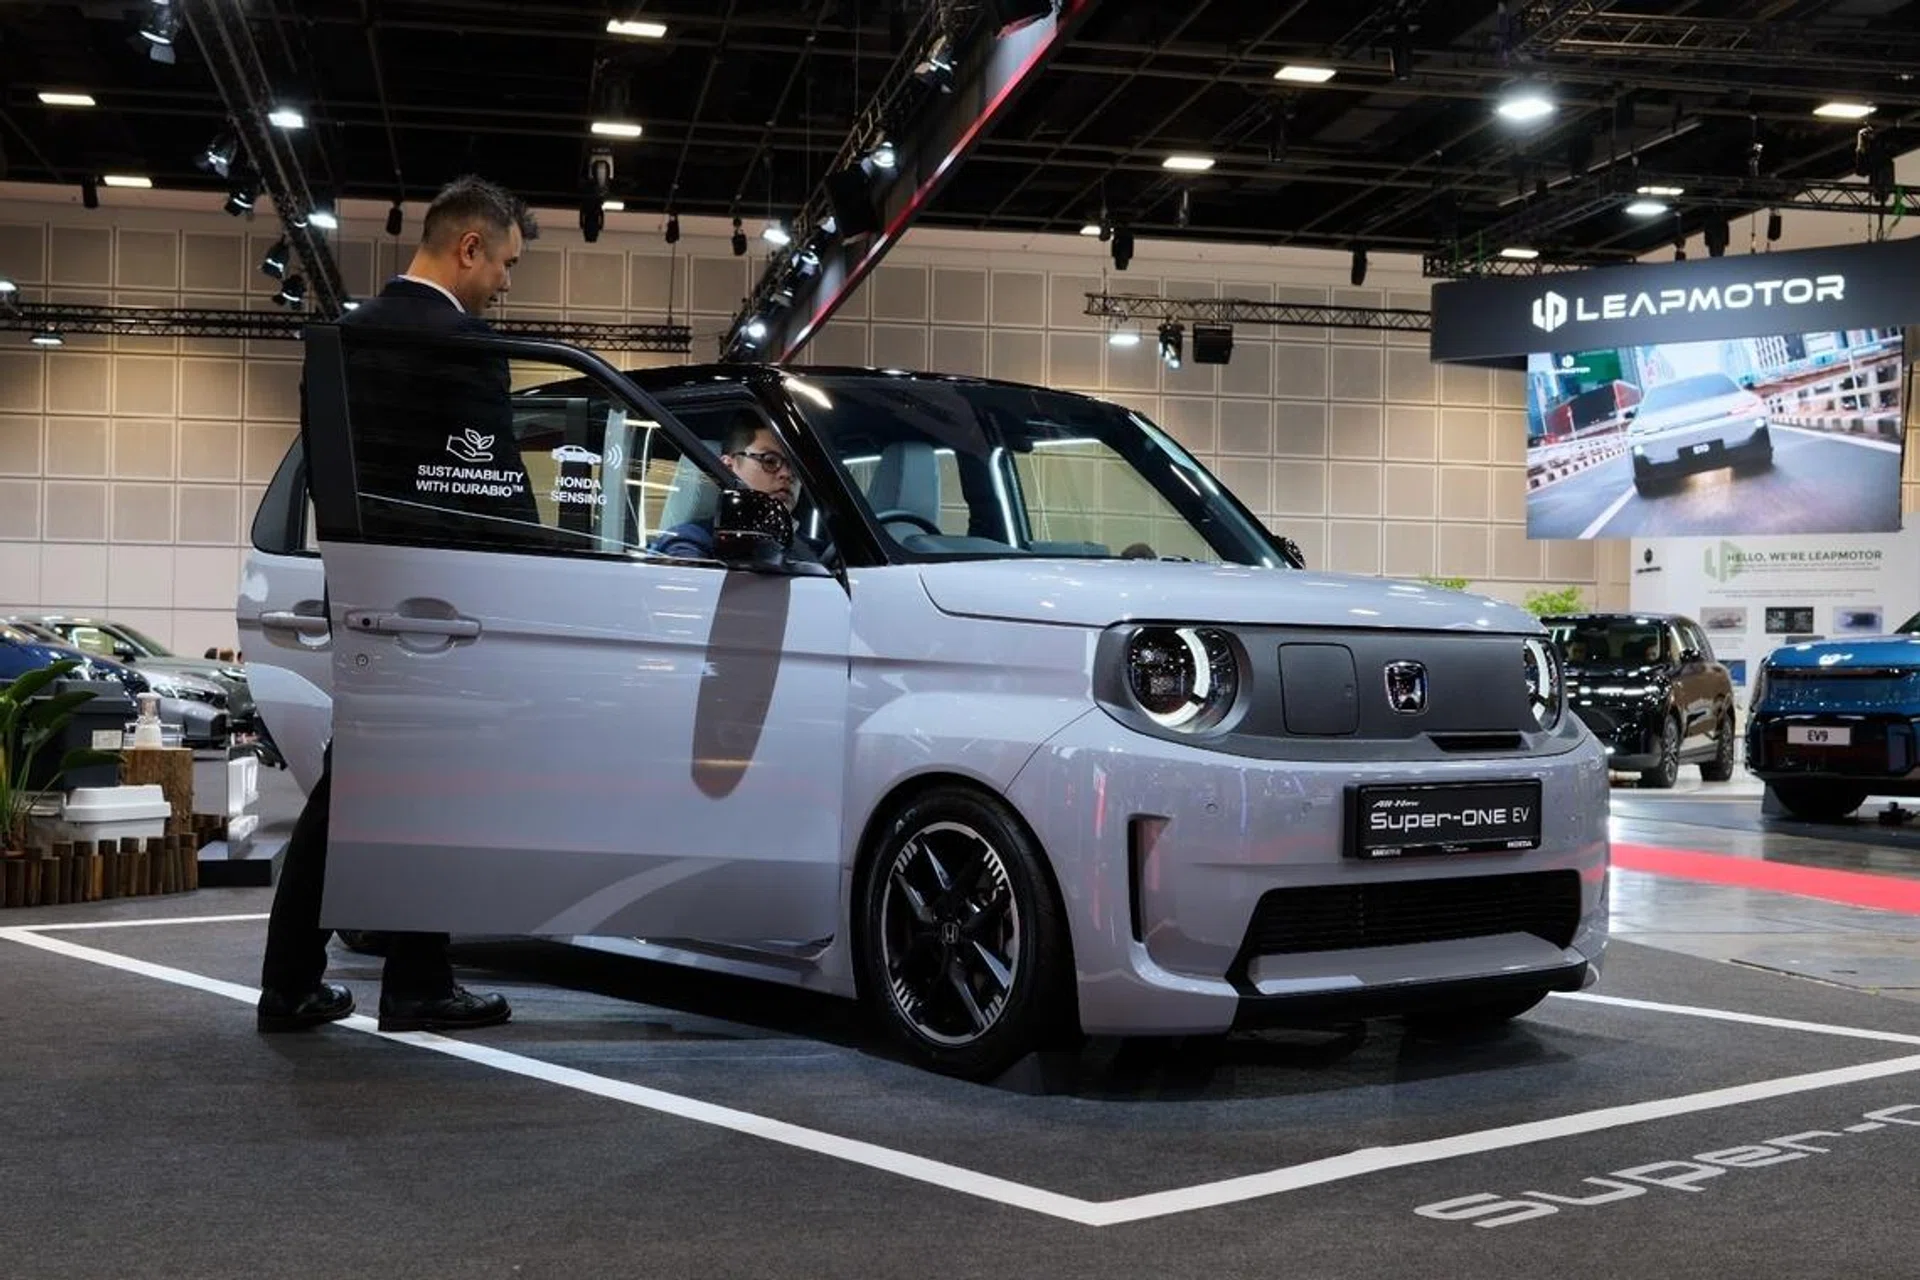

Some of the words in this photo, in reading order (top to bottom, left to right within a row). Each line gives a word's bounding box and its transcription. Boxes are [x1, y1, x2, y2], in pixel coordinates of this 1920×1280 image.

[1576, 274, 1846, 322] LEAPMOTOR
[417, 464, 524, 483] SUSTAINABILITY
[416, 479, 449, 493] WITH
[555, 476, 602, 490] HONDA
[550, 490, 608, 505] SENSING
[1808, 549, 1883, 562] LEAPMOTOR
[1807, 729, 1829, 742] EV9
[1370, 808, 1508, 834] Super-ONE
[1512, 806, 1531, 823] EV
